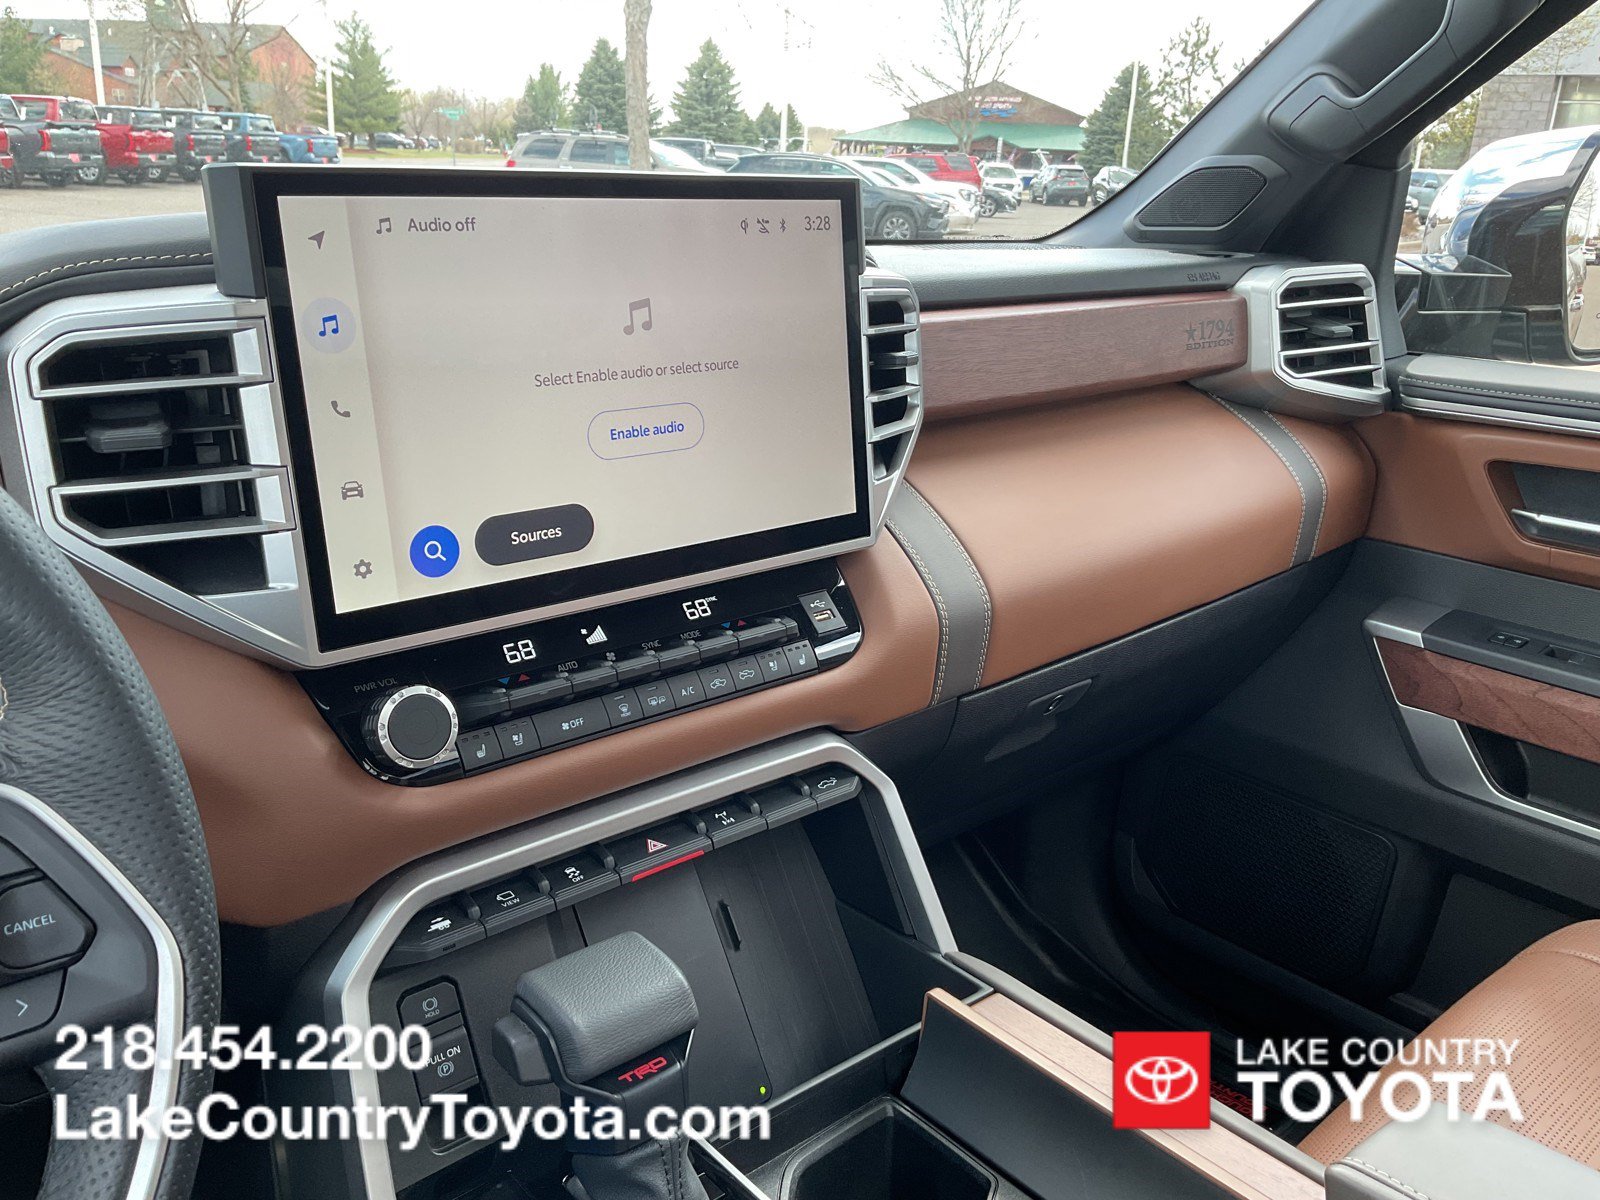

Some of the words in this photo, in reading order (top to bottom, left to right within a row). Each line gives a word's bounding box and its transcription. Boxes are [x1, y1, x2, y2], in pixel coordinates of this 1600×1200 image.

[407, 217, 452, 232] Audio
[455, 216, 476, 232] off
[804, 215, 831, 231] 3:28
[1199, 319, 1235, 340] 1794
[1185, 338, 1235, 351] EDITION
[534, 372, 574, 388] Select
[576, 368, 619, 384] Enable
[620, 364, 653, 380] audio
[655, 365, 668, 376] or
[670, 361, 702, 375] select
[704, 359, 739, 372] source
[609, 425, 651, 441] Enable
[652, 420, 685, 436] audio
[510, 526, 563, 545] Sources
[682, 598, 712, 620] 68
[680, 629, 702, 641] MODE
[502, 638, 537, 664] 68
[641, 638, 662, 651] SYNC
[557, 660, 579, 672] AUTO
[353, 681, 378, 693] PWR
[377, 677, 398, 687] VOL
[681, 686, 695, 697] A/C
[569, 716, 585, 729] OFF
[501, 897, 520, 907] VIEW
[3, 913, 57, 936] CANCEL
[425, 1009, 440, 1019] HOLD
[425, 1052, 446, 1068] PULL
[446, 1045, 462, 1058] ON
[617, 1056, 668, 1083] TRD
